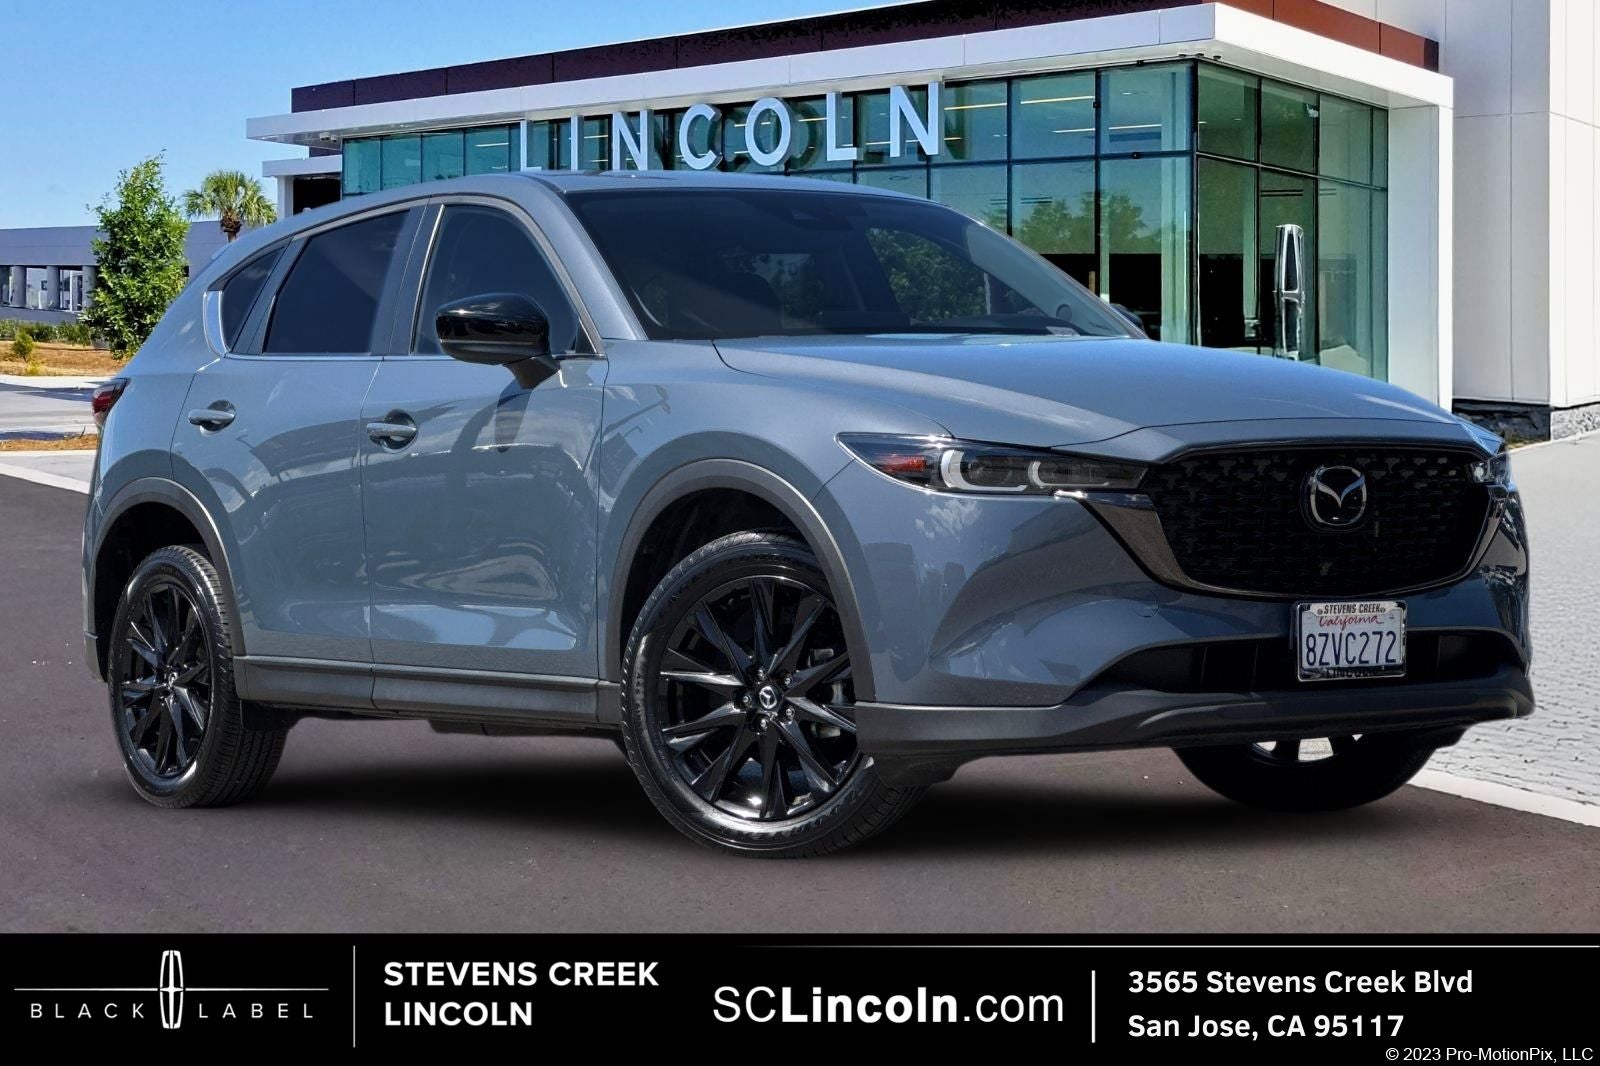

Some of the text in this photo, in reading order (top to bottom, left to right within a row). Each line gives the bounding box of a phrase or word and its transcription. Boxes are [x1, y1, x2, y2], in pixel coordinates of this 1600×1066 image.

[520, 81, 942, 171] LINCOLN
[1323, 603, 1381, 615] STEVENS CREEK
[1318, 615, 1384, 631] California
[1305, 630, 1397, 667] 8ZVC272
